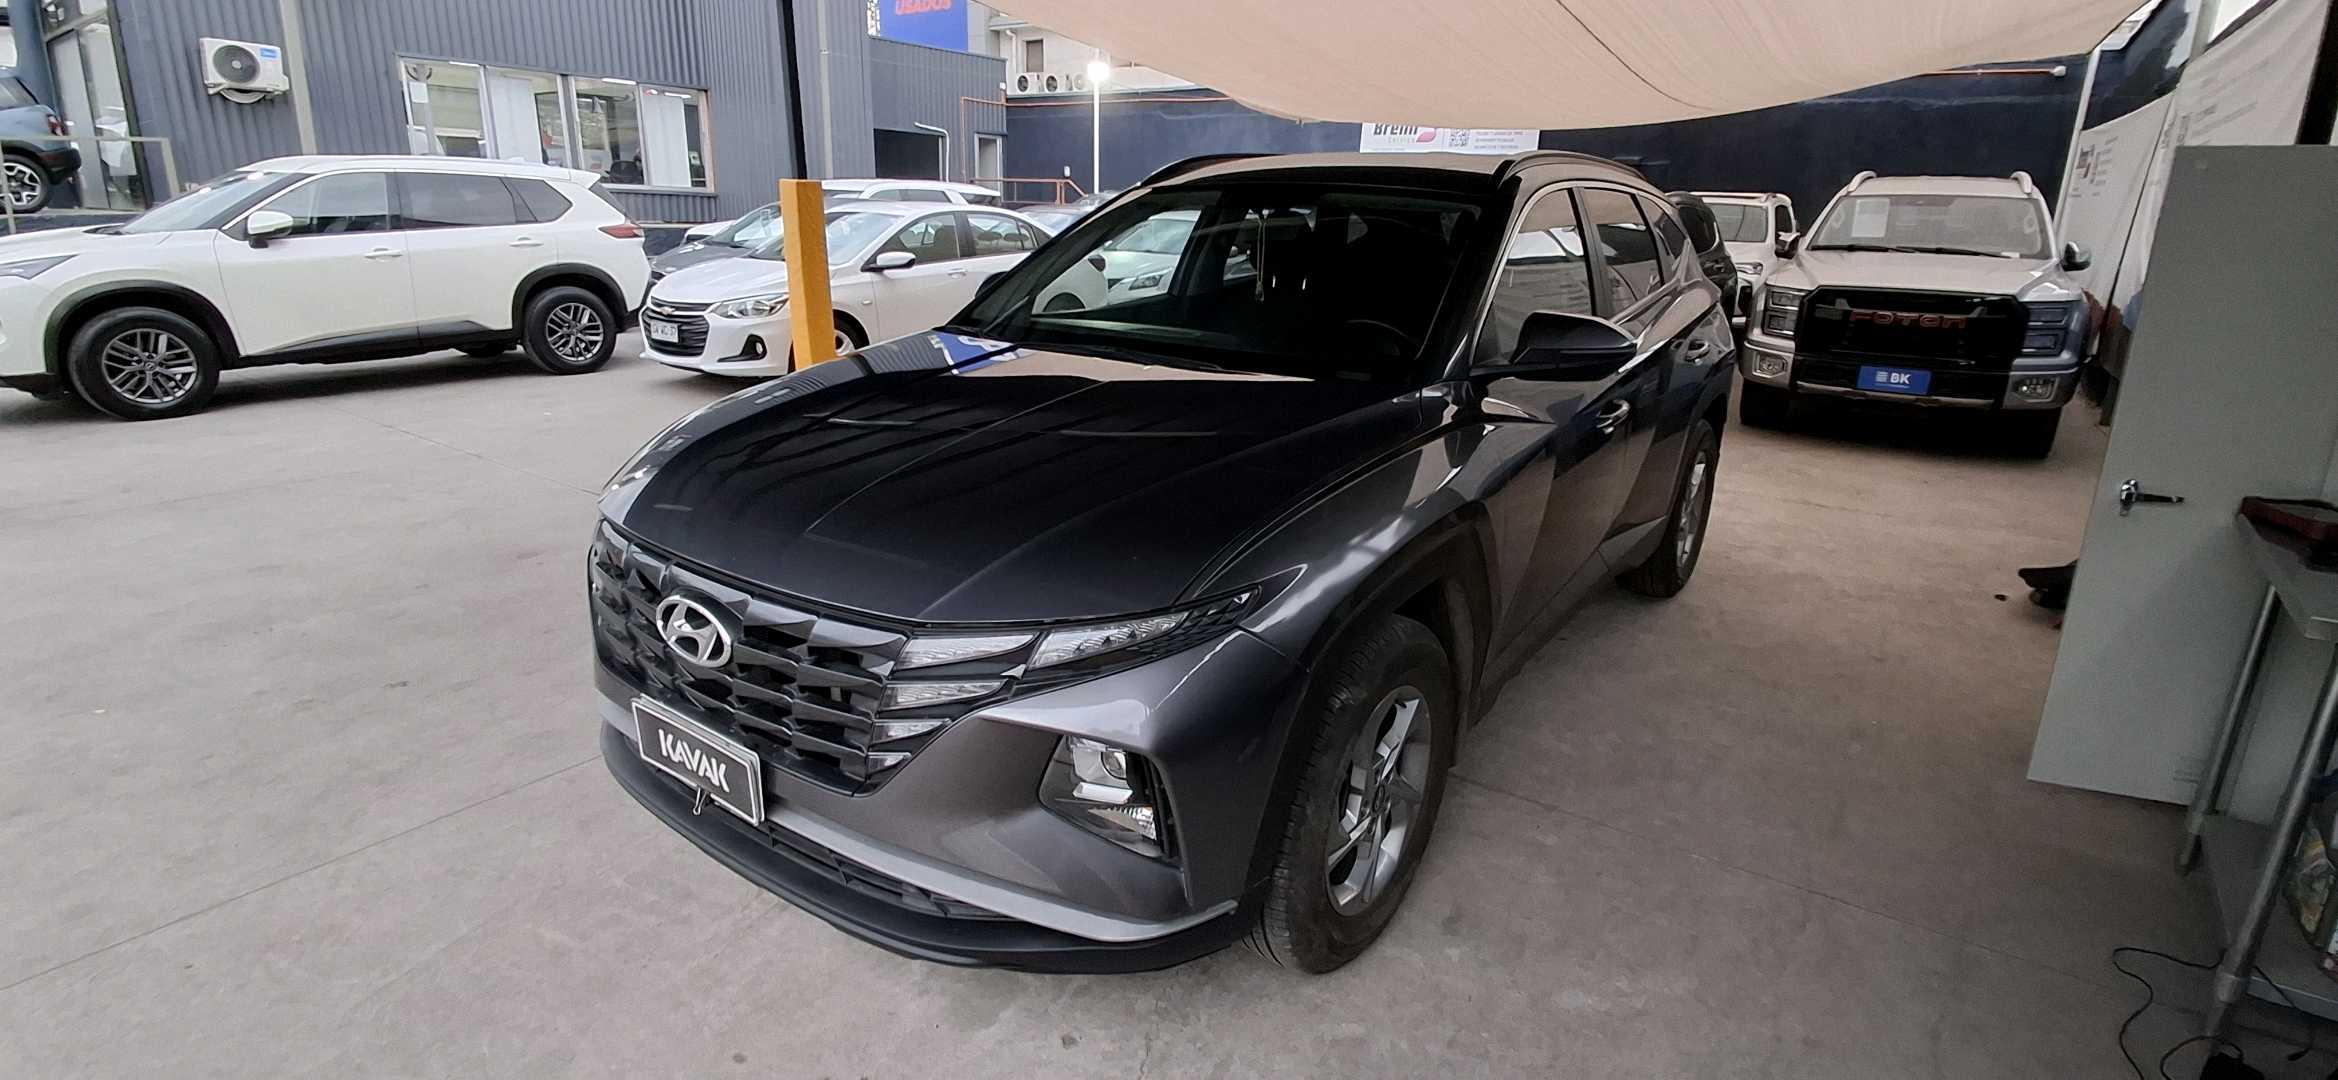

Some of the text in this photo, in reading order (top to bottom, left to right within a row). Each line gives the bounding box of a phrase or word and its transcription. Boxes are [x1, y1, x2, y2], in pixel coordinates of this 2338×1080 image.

[1850, 309, 1968, 329] FOTON
[1890, 372, 1912, 385] BK
[658, 728, 730, 793] KAVAK
